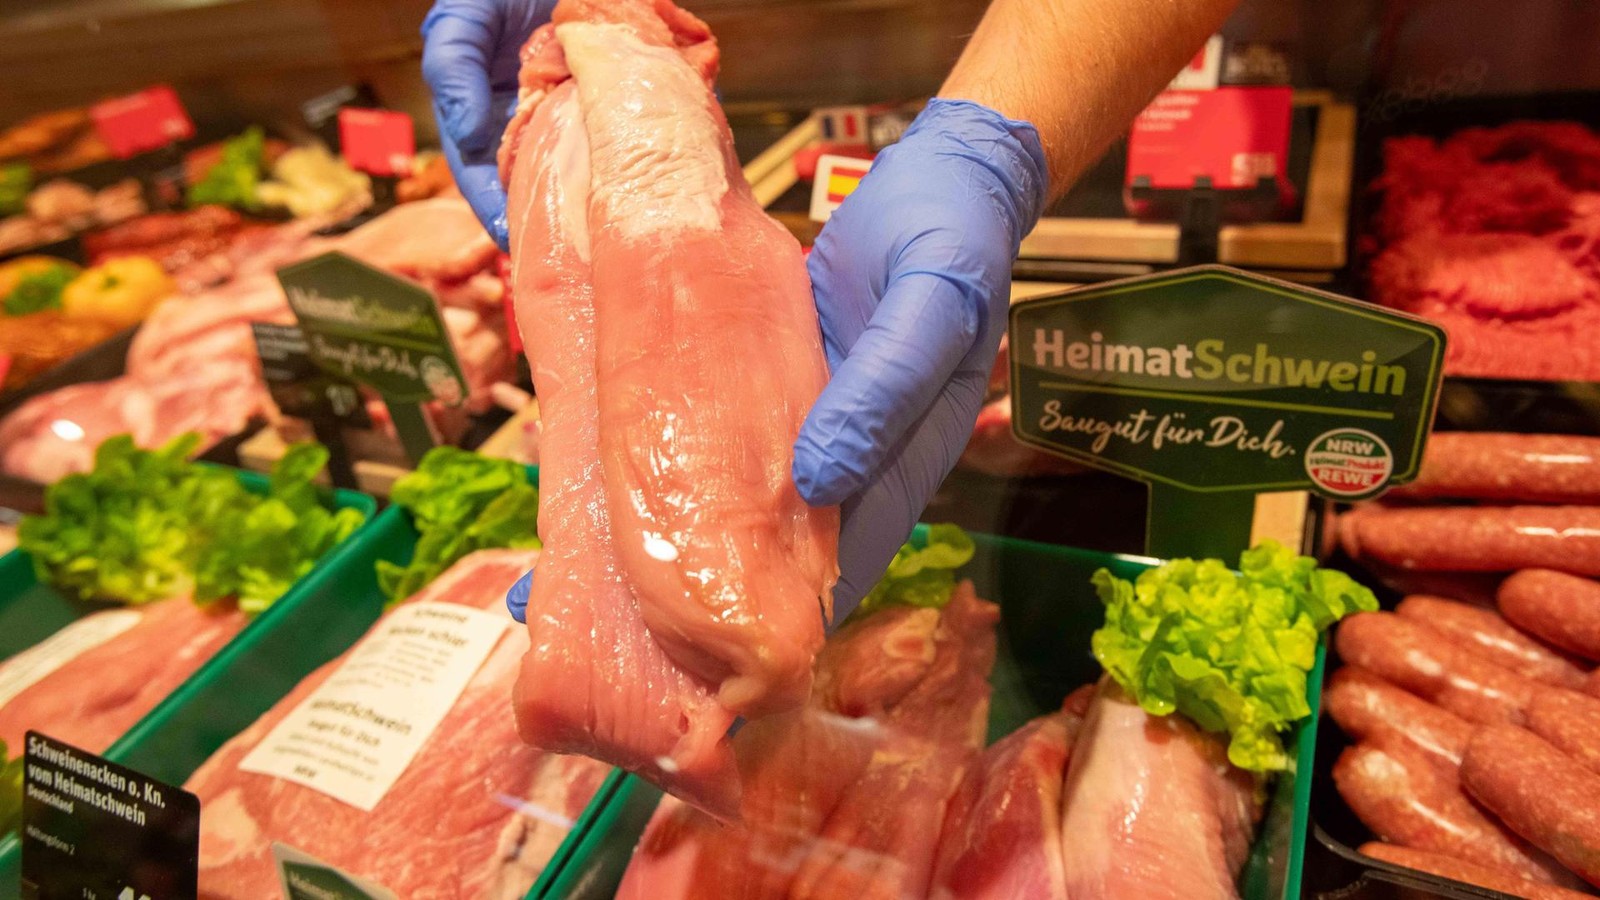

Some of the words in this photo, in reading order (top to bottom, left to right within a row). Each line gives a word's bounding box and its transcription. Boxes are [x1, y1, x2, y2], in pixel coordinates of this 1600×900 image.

[1033, 328, 1407, 396] HeimatSchwein
[1039, 400, 1155, 453] Saugut
[1152, 412, 1204, 450] für
[1204, 416, 1296, 459] Dich.
[1325, 438, 1375, 456] NRW
[1318, 469, 1374, 487] REWE
[27, 782, 74, 815] Deutschland
[28, 736, 126, 792] Schweinenacken
[128, 780, 141, 798] o.
[144, 782, 166, 809] Kn.
[28, 763, 53, 786] vom
[54, 771, 146, 827] Heimatschwein
